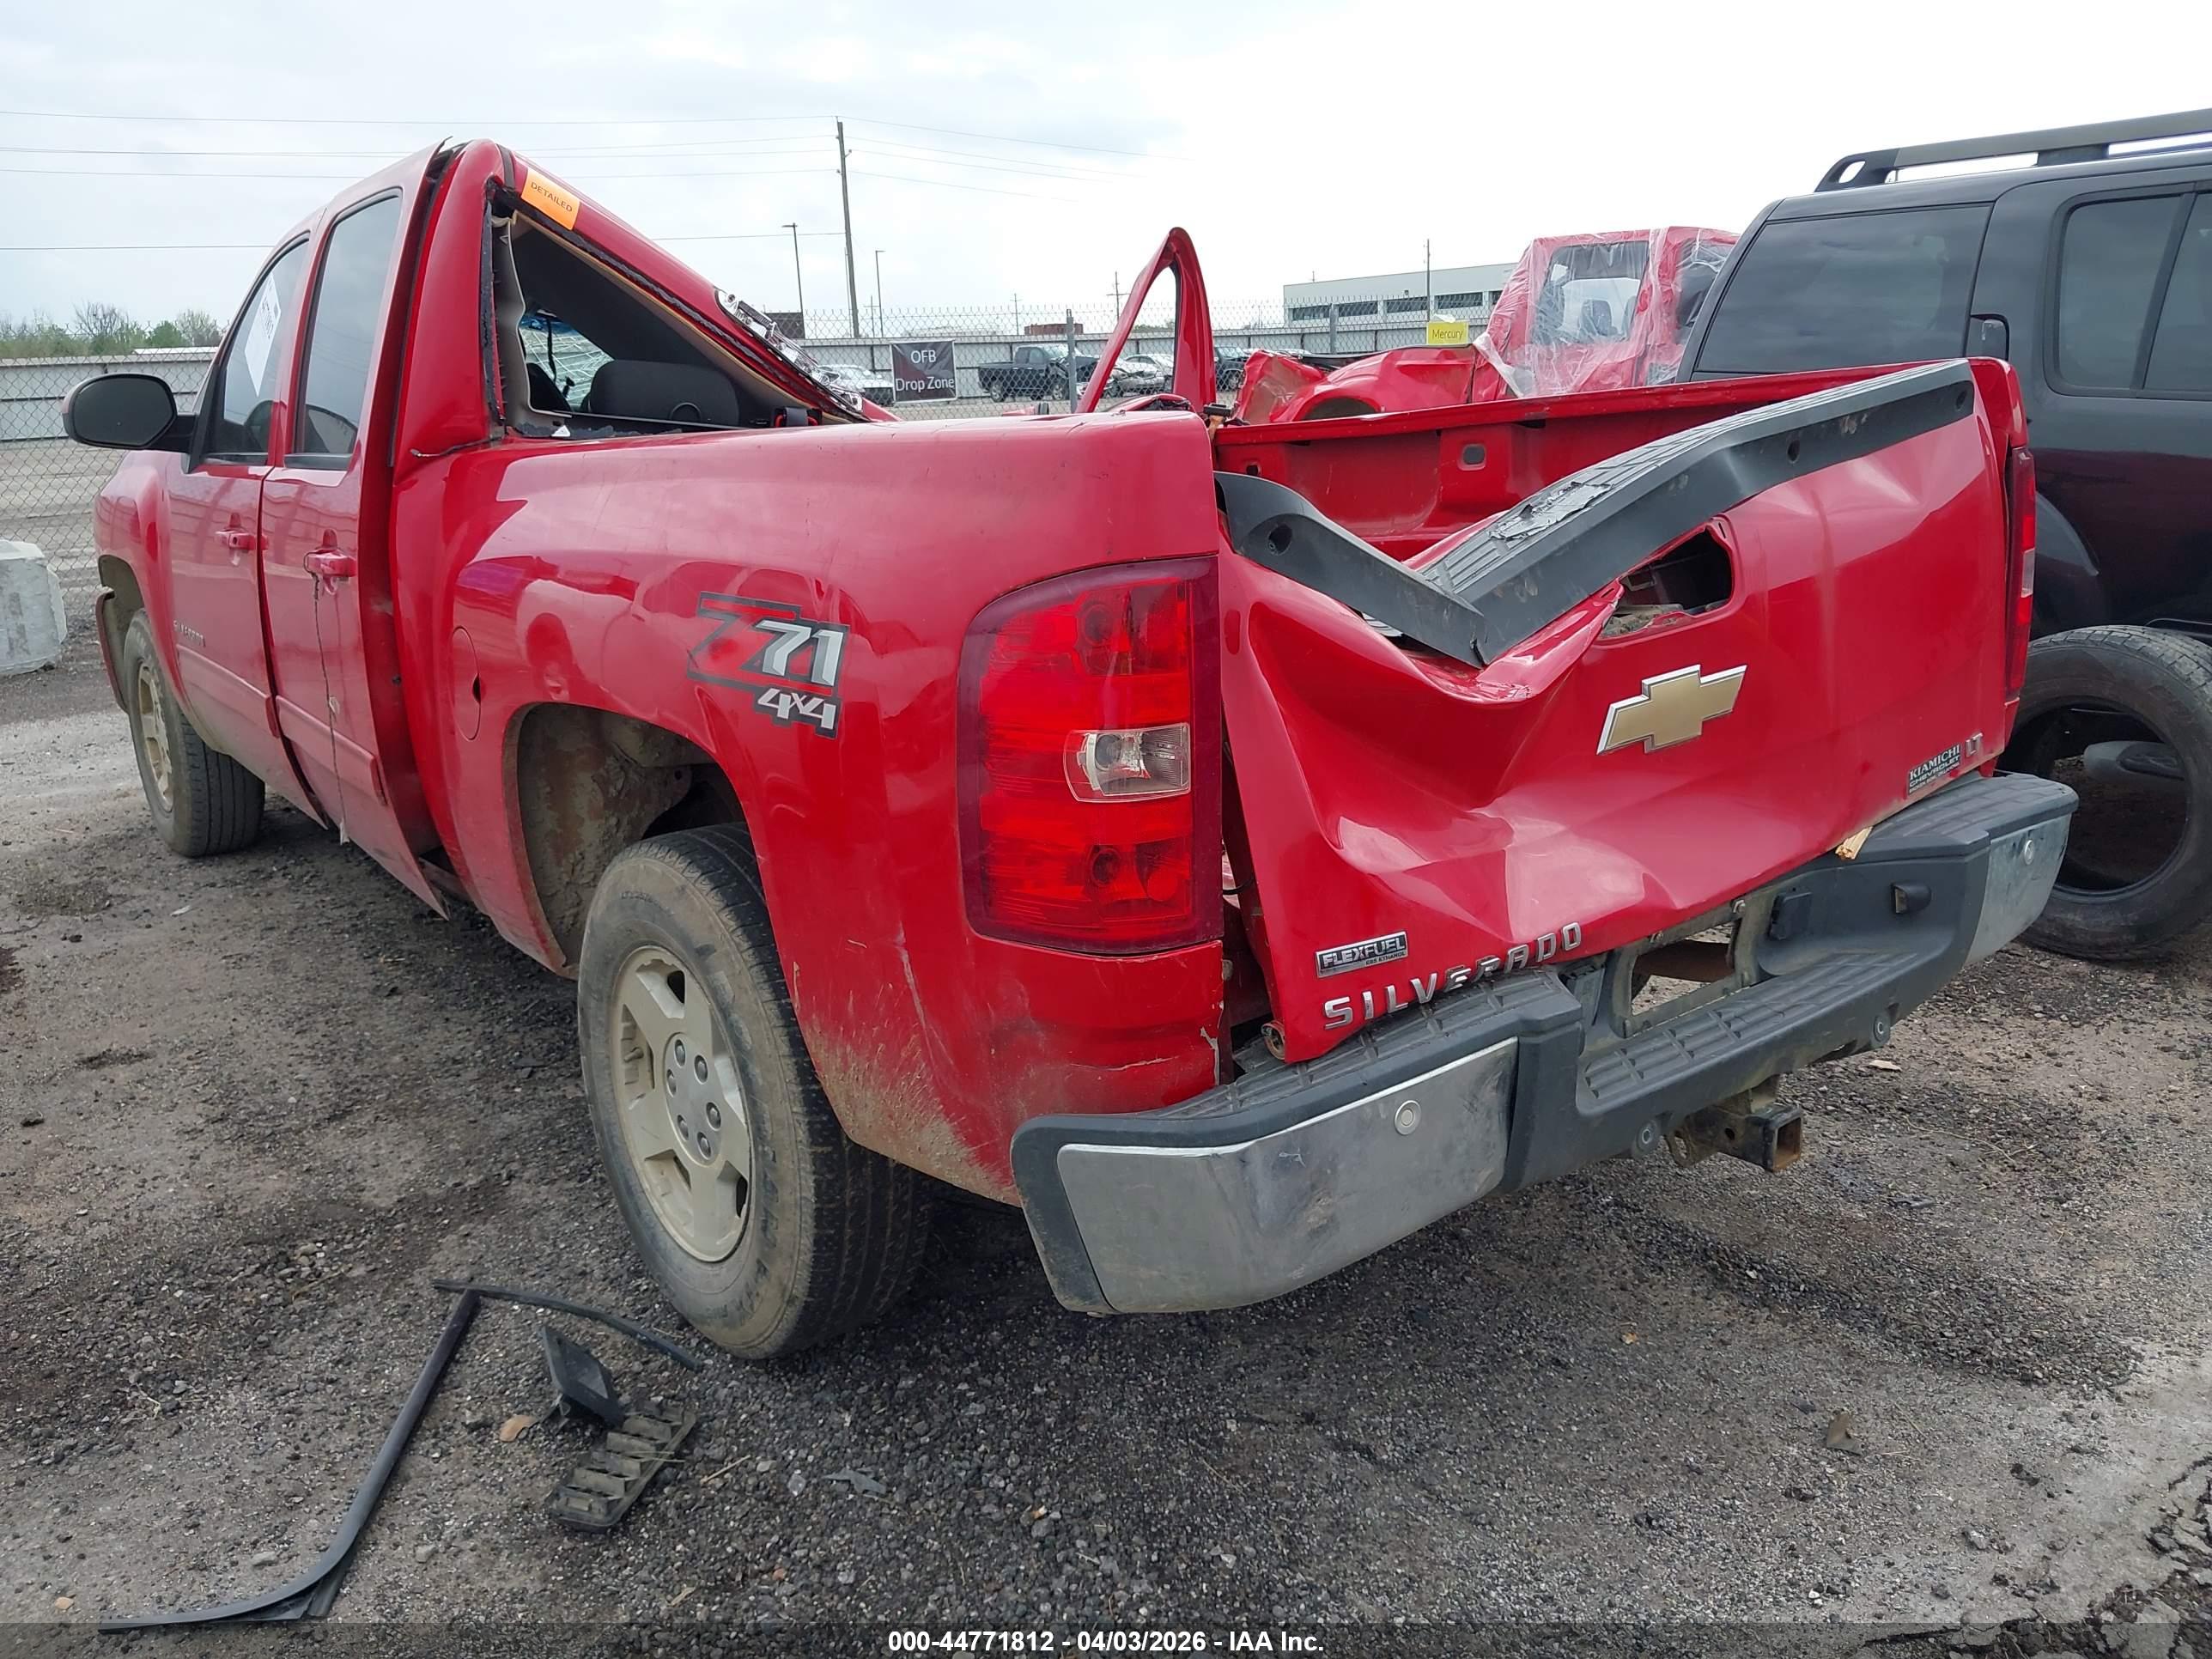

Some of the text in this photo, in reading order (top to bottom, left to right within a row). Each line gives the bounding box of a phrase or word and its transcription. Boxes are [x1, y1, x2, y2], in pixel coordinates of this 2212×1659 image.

[531, 181, 573, 212] DETAILED
[1431, 329, 1463, 340] Mercury
[910, 349, 937, 364] OFB
[895, 376, 955, 393] Drop Zone
[687, 591, 850, 689] Z71
[1965, 732, 1984, 757] LT
[1909, 744, 1960, 780] KIAMICHI
[1909, 755, 1960, 787] CHEVROLET
[1322, 936, 1406, 968] FLEXFUEL
[1378, 951, 1407, 964] ETHANOL
[1323, 921, 1582, 1030] SILVERADO
